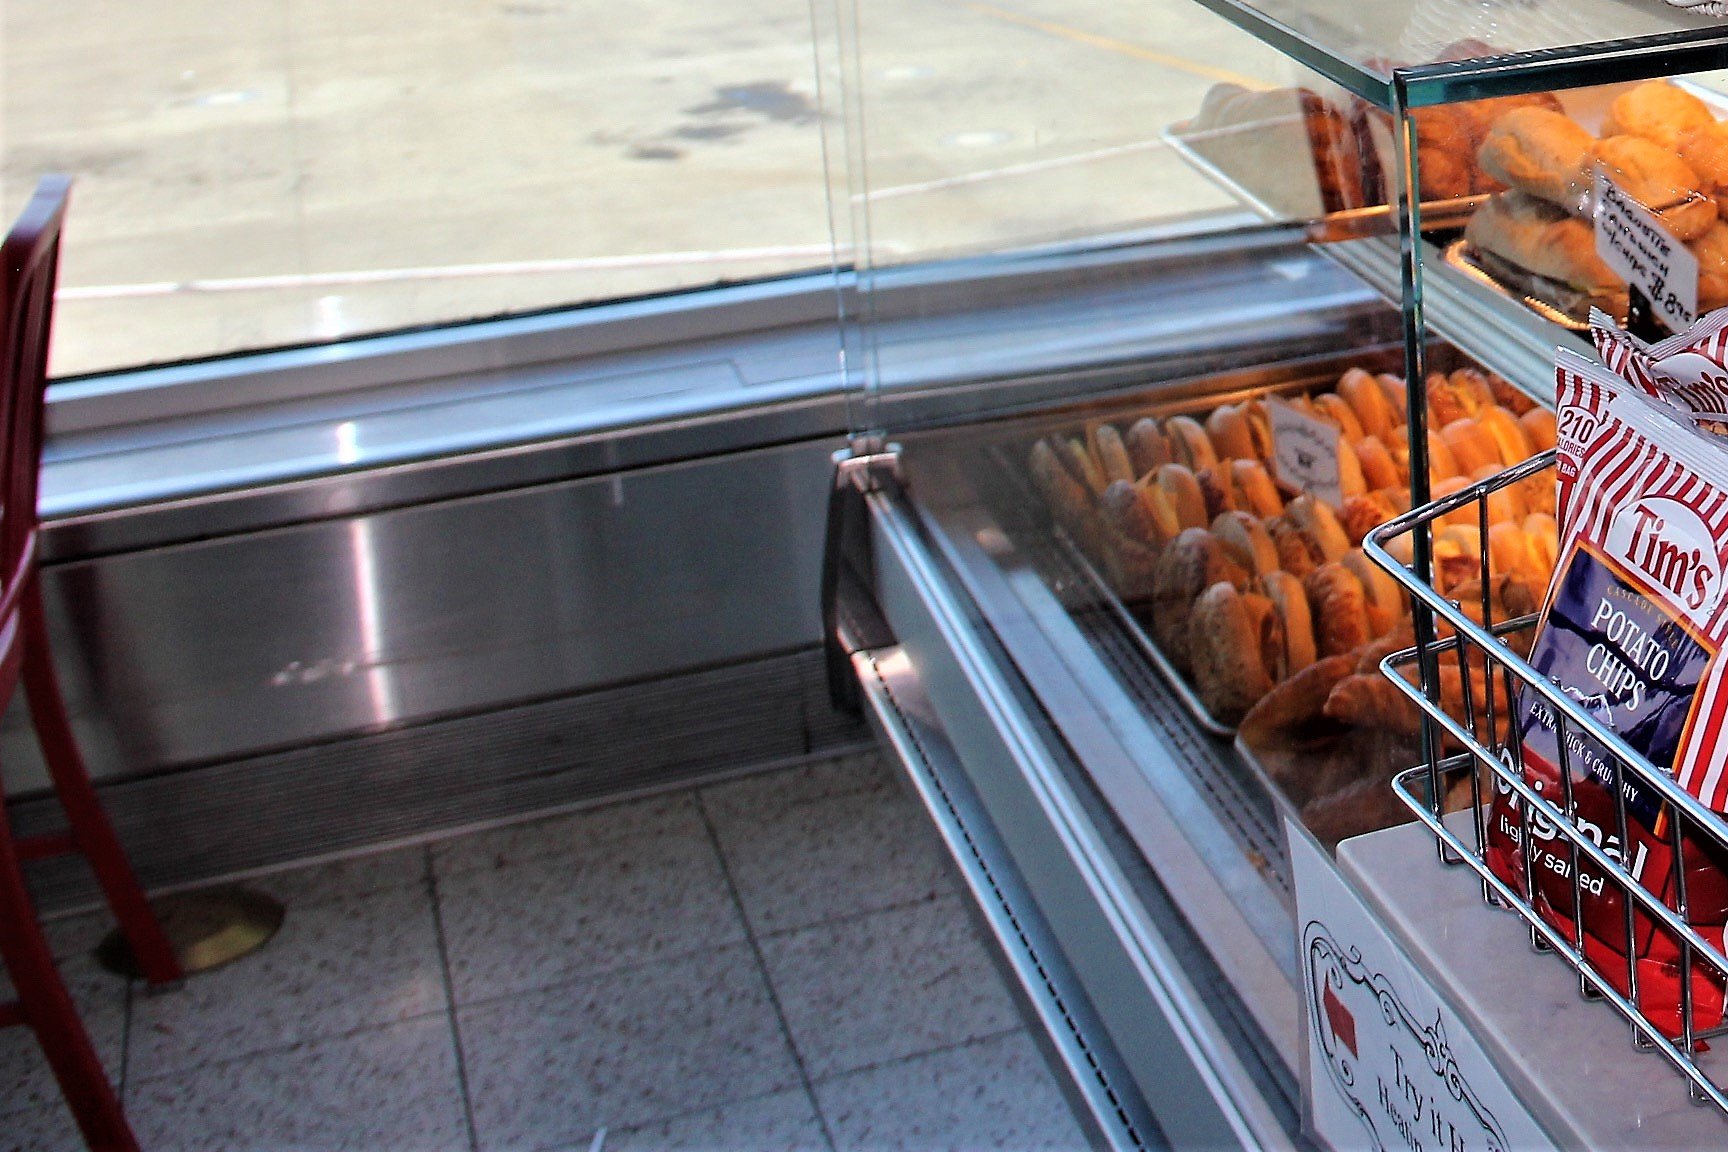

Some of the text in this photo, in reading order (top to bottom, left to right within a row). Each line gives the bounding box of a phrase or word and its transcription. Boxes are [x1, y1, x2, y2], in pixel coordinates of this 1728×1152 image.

[1556, 437, 1587, 459] LORIES
[1559, 409, 1595, 445] 210
[1562, 462, 1577, 478] BAG
[1624, 503, 1714, 611] Tim's
[1586, 643, 1647, 712] CHIPS
[1590, 597, 1671, 682] POTATO
[1529, 703, 1639, 803] EXTRA HICK & CRUHY
[1498, 747, 1649, 882] Orignal
[1500, 814, 1605, 897] ligly saled
